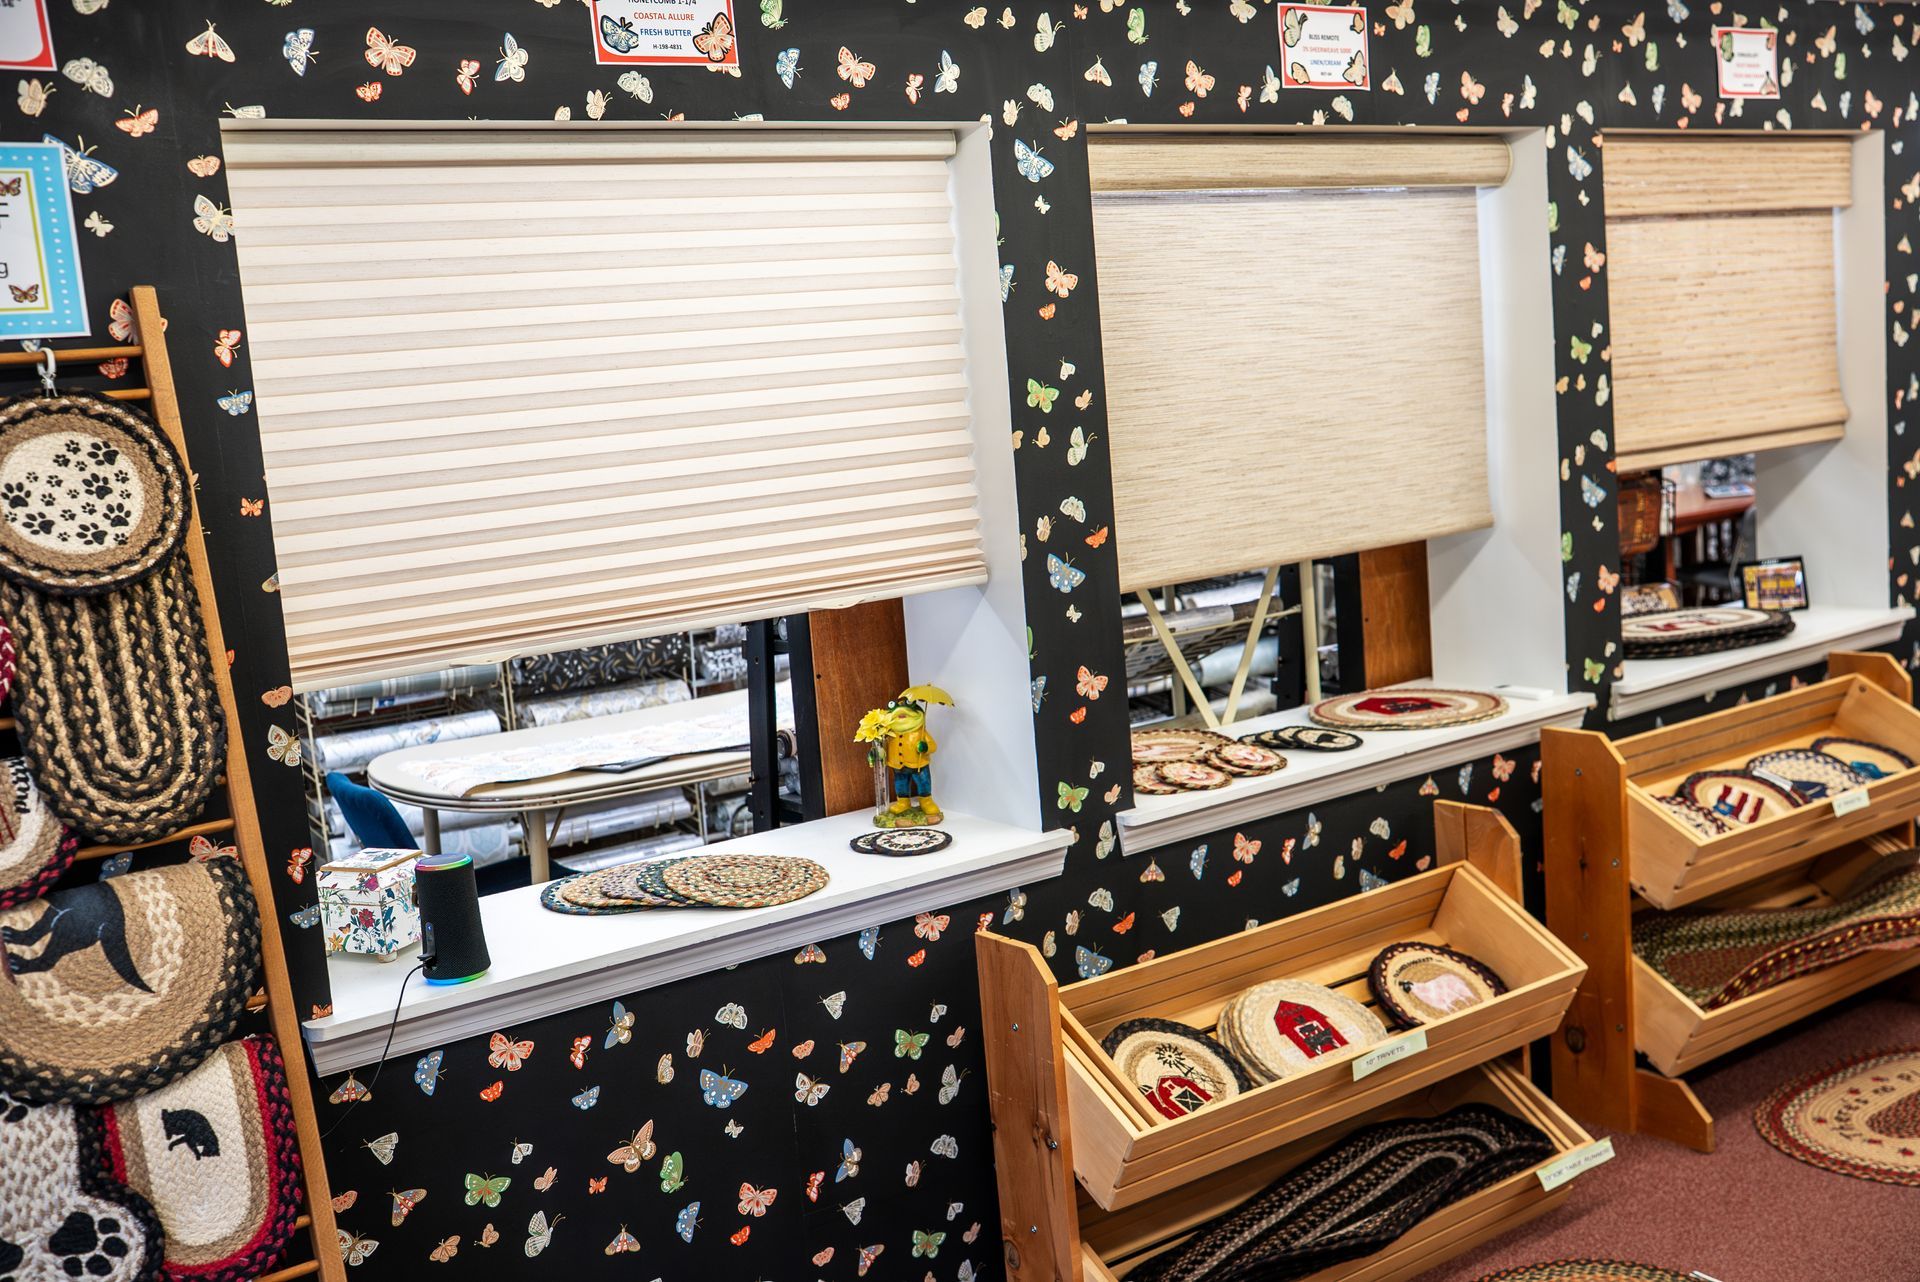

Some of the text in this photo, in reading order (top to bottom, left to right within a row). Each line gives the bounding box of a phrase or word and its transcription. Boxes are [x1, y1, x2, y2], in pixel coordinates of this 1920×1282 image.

[633, 12, 667, 20] COASTAL
[640, 28, 663, 36] FRESH
[1377, 1045, 1405, 1061] TRIVETS
